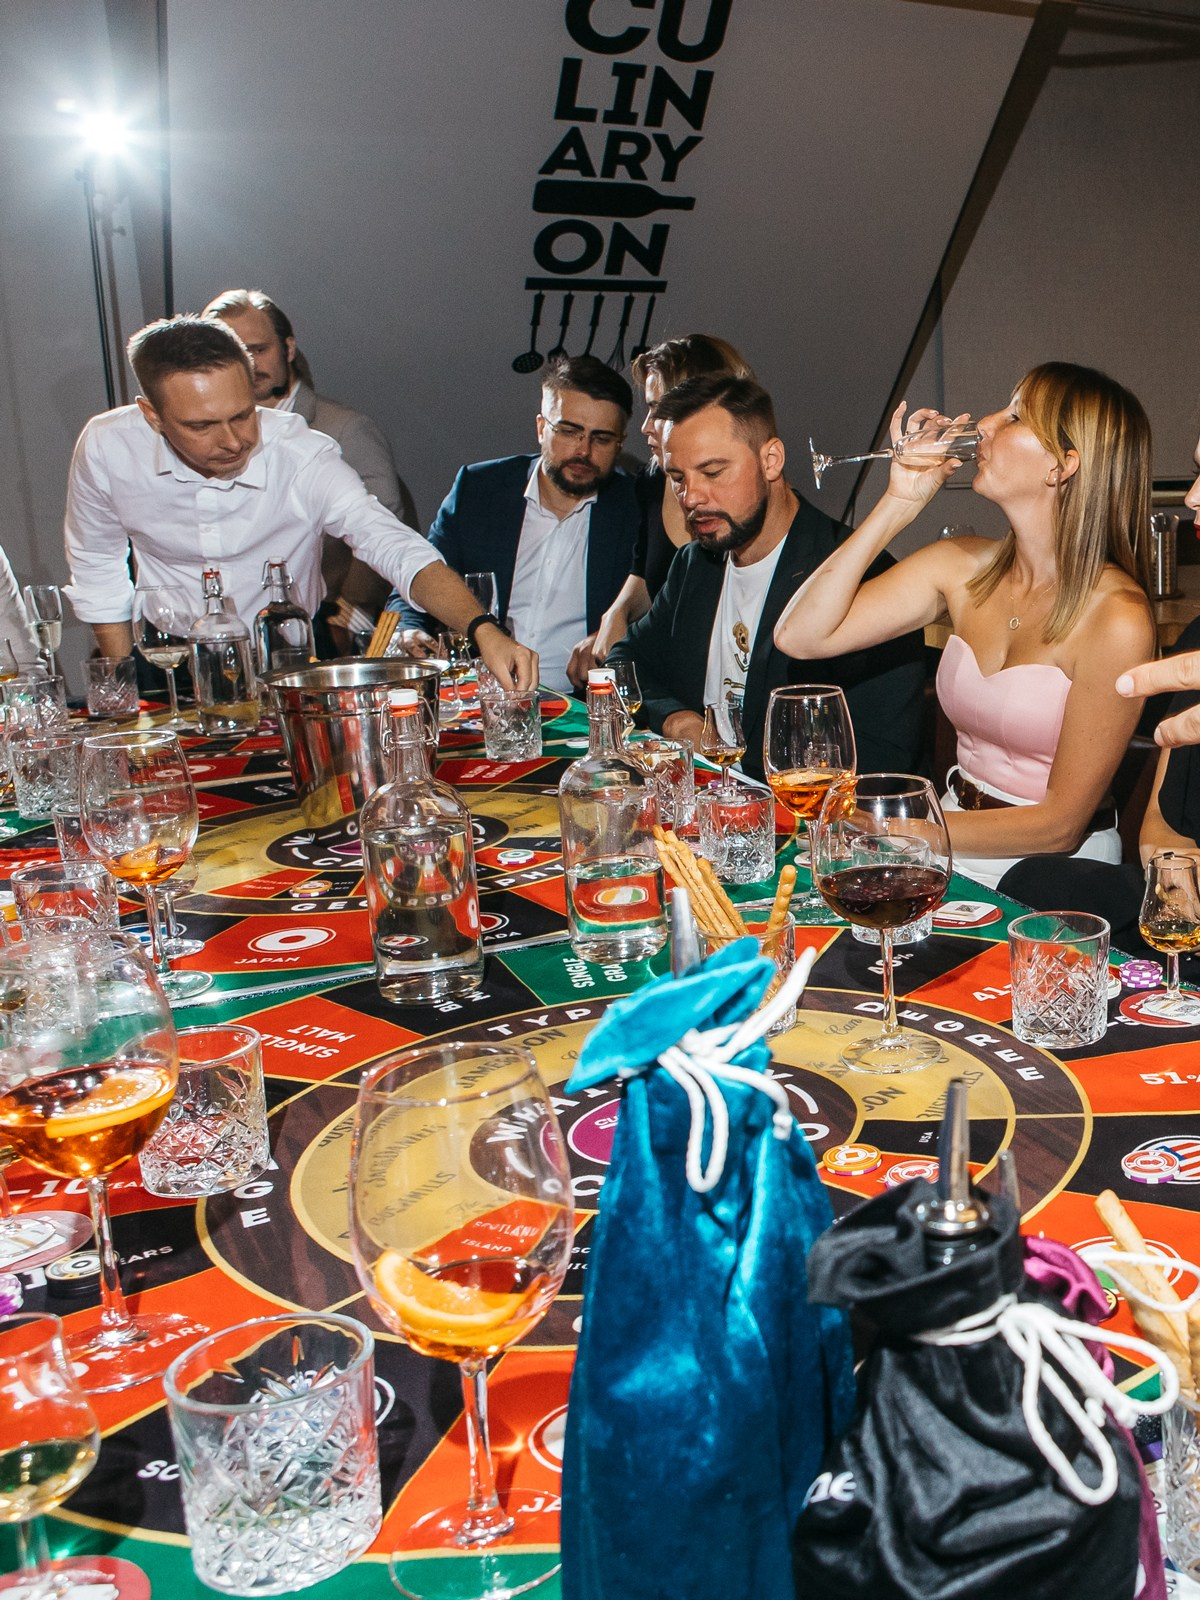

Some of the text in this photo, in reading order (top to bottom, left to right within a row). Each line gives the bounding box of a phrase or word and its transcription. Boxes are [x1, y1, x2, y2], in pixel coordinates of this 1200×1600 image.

[565, 0, 733, 62] CU
[554, 57, 714, 131] LIN
[538, 126, 704, 182] ARY
[533, 219, 670, 276] ON
[233, 956, 301, 966] JAPAN
[562, 957, 596, 989] SINGLE
[600, 962, 629, 983] GRA
[286, 1024, 356, 1043] MALT
[487, 1002, 614, 1037] TYP
[853, 1001, 1046, 1082] DEGREE
[118, 1245, 174, 1265] EARS
[460, 1238, 513, 1253] ISLAND
[136, 1322, 211, 1353] YEARS
